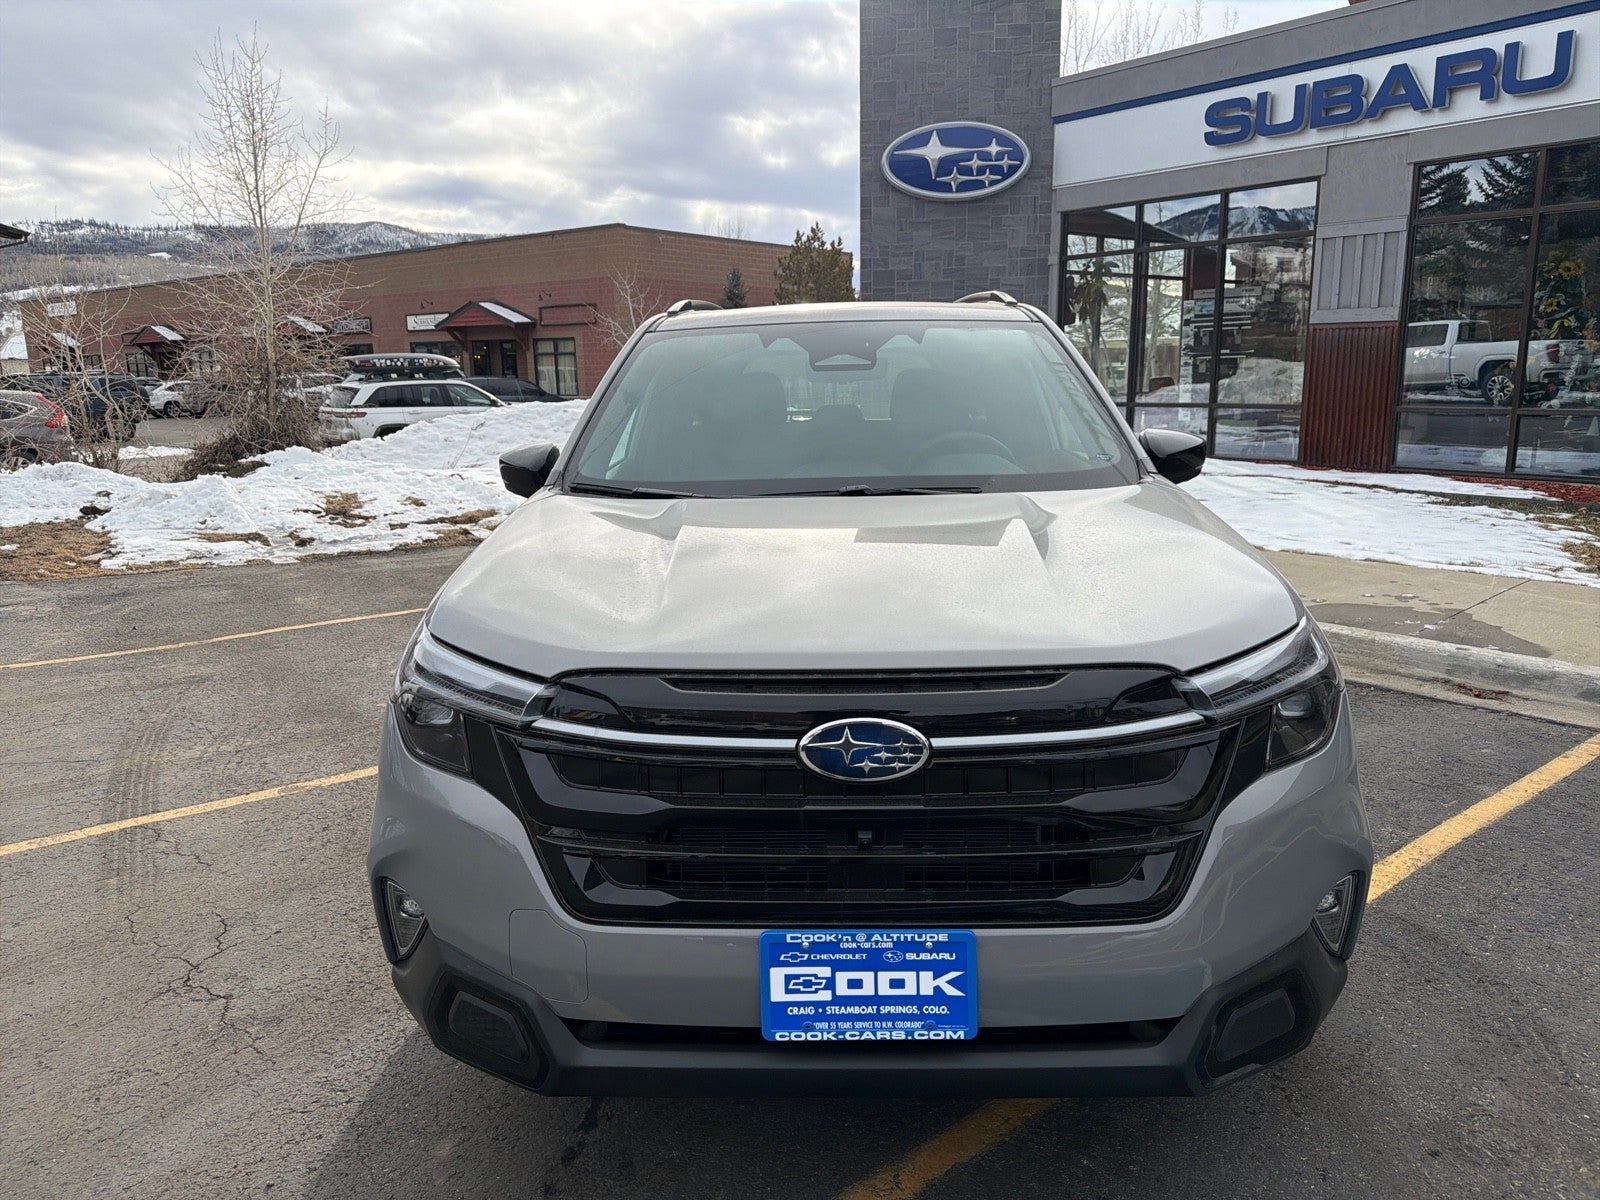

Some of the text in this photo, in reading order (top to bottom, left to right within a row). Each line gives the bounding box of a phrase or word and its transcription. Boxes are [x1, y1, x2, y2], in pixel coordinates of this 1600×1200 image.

[1203, 29, 1576, 147] SUBARU
[786, 933, 949, 943] COOK'n @ ALTITUDE
[839, 941, 894, 949] cook-cars.com
[905, 952, 956, 960] SUBARU
[769, 966, 967, 1003] COOK
[787, 1005, 950, 1015] CRAIG STEAMBOAT SPRINGS, COLO.
[813, 1020, 925, 1030] "OVER 55 YEARS SERVICE TO N.W. COLORADO"
[774, 1030, 965, 1041] COOK-CARS.COM
